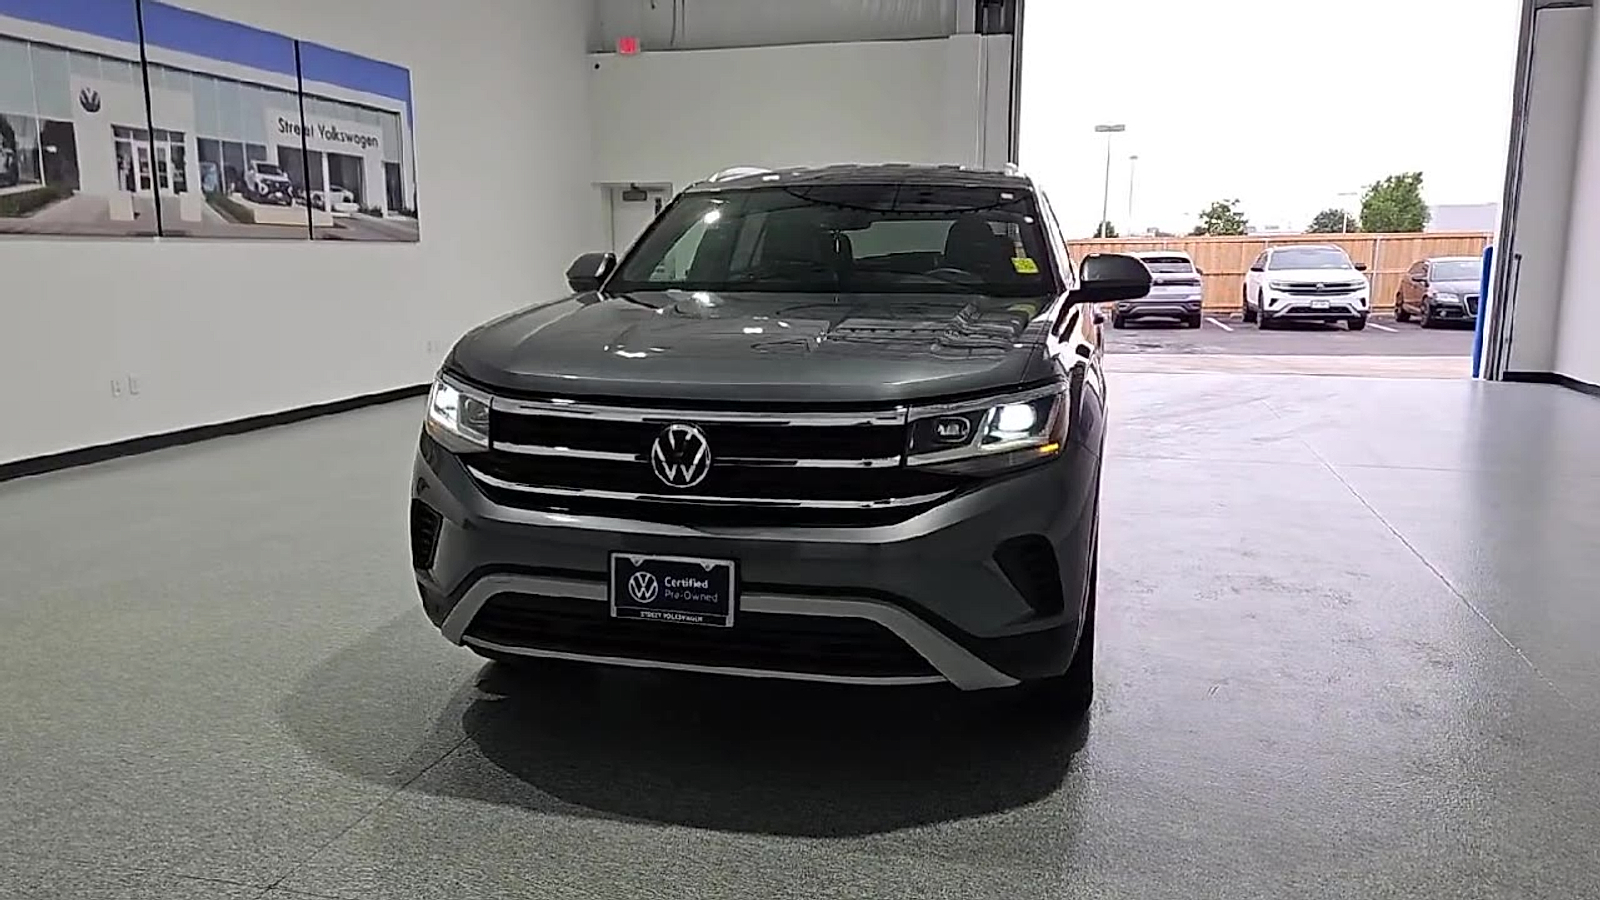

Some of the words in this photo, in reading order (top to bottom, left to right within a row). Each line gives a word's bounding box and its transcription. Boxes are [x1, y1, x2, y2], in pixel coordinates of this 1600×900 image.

[318, 124, 379, 149] Volkswagen
[664, 576, 709, 589] Certified
[664, 588, 718, 603] Pre-Owned
